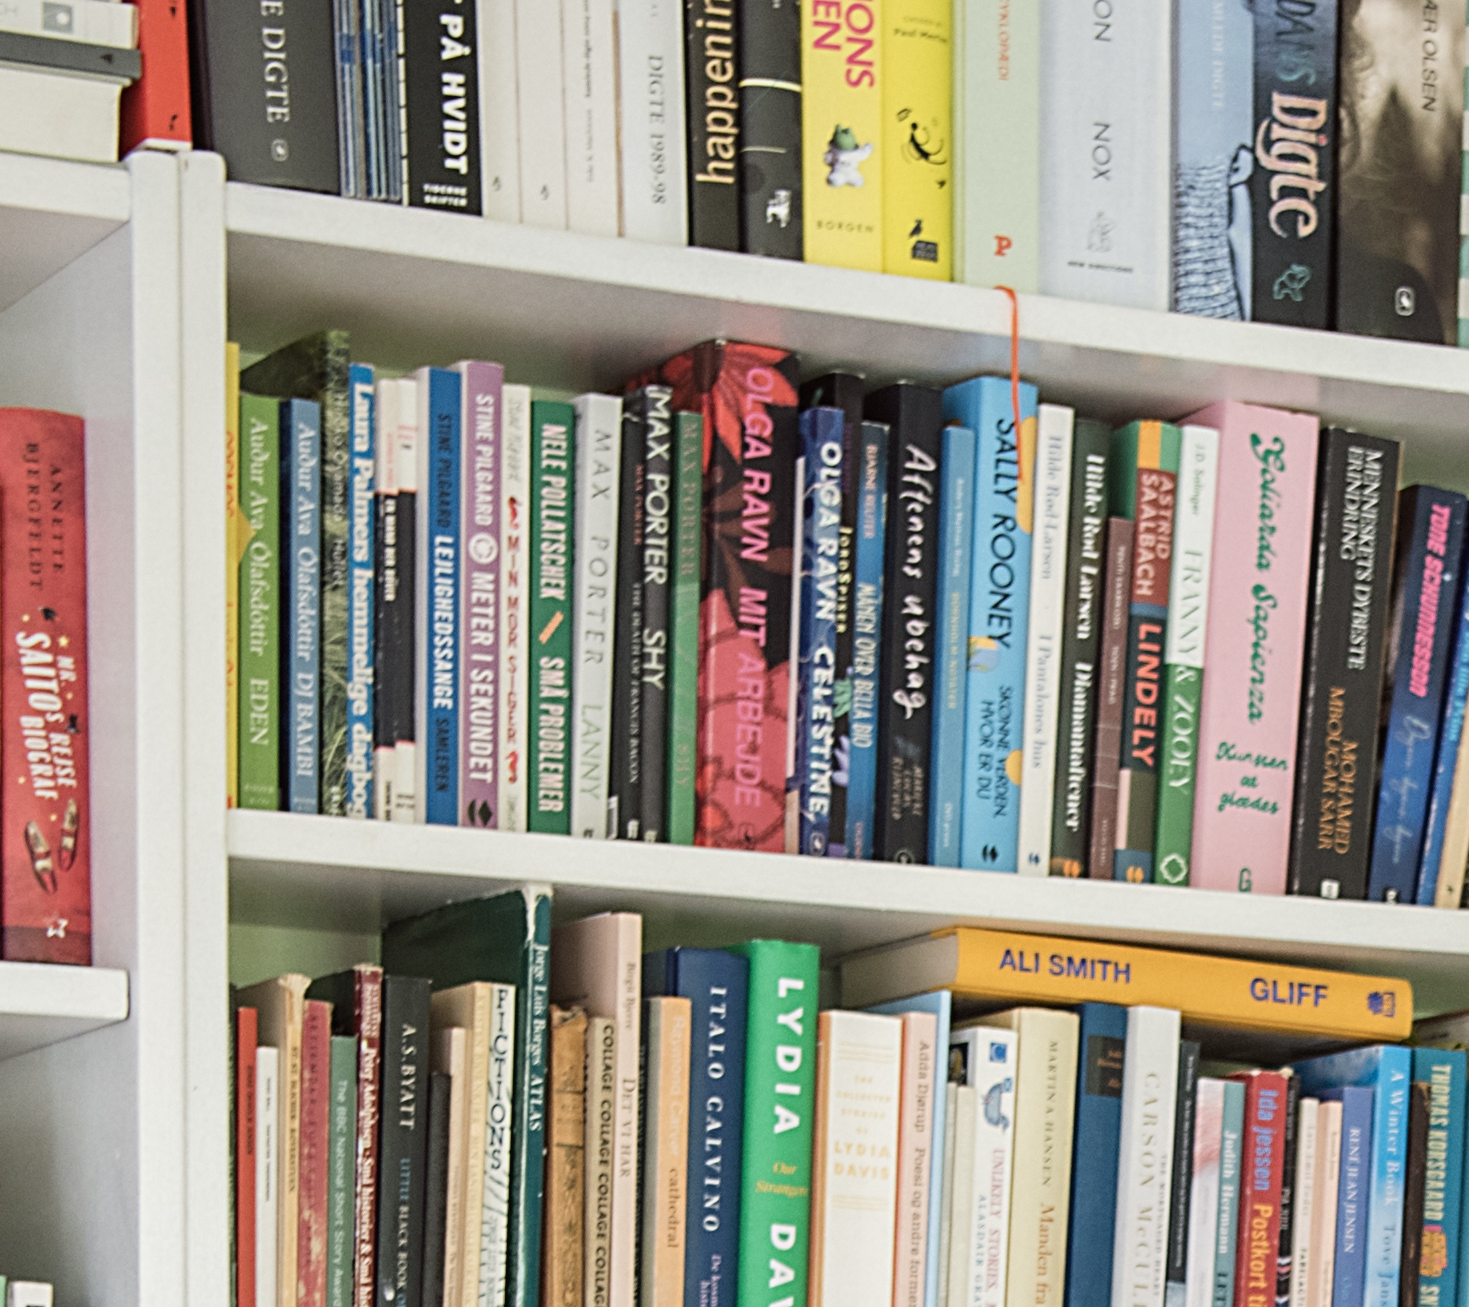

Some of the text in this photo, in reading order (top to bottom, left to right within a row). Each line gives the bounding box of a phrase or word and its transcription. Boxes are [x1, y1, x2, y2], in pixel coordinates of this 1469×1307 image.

[439, 18, 470, 175] PÅ HVIDT
[1092, 122, 1111, 182] NOX
[1253, 91, 1327, 239] Digte
[732, 367, 774, 807] OLGA RAVN MIT ARBEJDE
[987, 419, 1017, 649] SALLY ROONEY
[250, 678, 268, 746] EDEN
[1131, 624, 1162, 767] LINDELY
[999, 950, 1328, 1007] ALI SMITH GLIFF
[774, 978, 804, 1134] LYDIA
